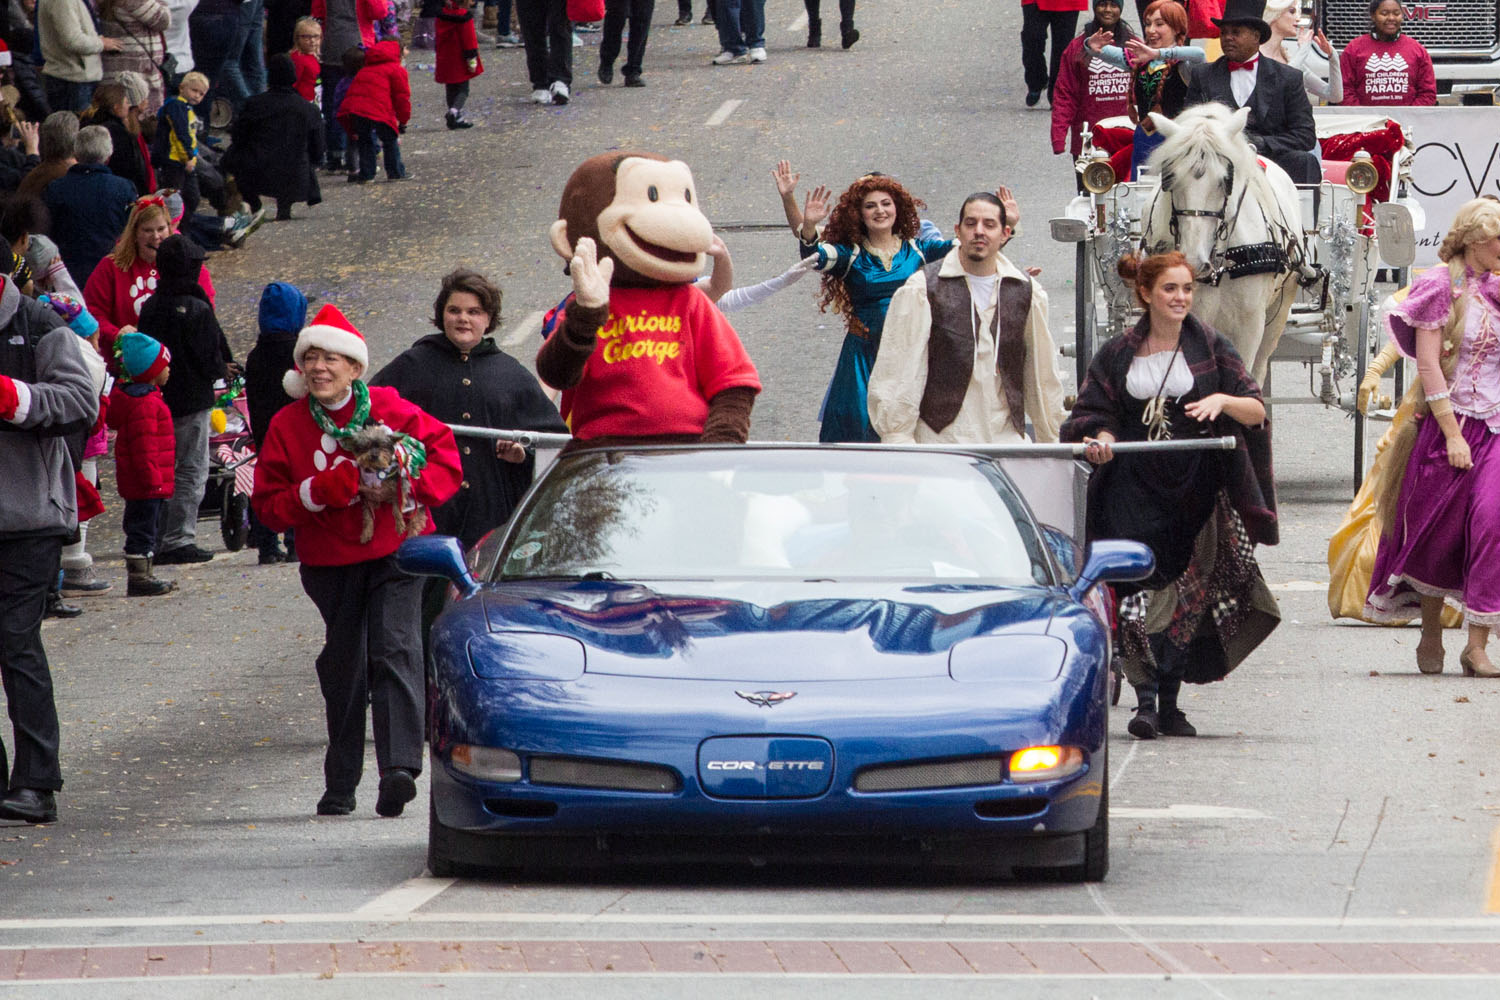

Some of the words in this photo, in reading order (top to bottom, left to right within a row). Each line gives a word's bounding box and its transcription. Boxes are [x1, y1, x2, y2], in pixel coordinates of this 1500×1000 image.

[1401, 5, 1447, 21] MC
[1365, 77, 1409, 86] CHRISTMAS
[1365, 84, 1409, 94] PARADE
[596, 310, 682, 339] Curious
[603, 339, 680, 365] George
